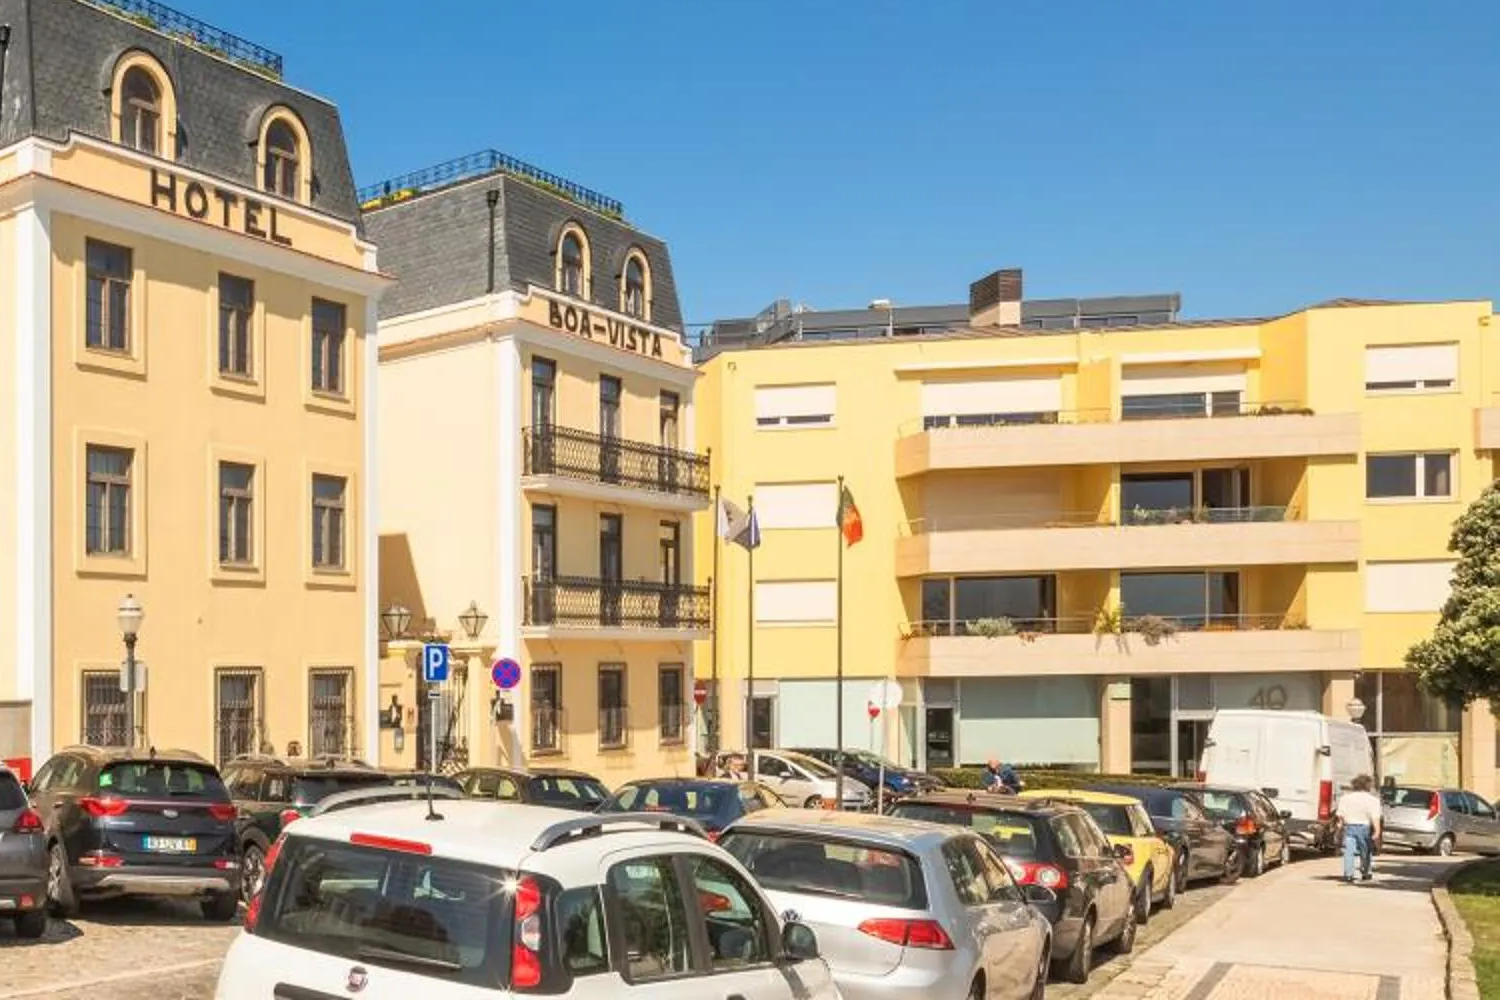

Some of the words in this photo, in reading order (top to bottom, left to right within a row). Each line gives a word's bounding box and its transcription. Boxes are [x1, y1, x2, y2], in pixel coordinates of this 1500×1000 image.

[150, 168, 293, 246] HOTEL
[549, 299, 662, 356] BOA-VISTA
[429, 647, 443, 679] P
